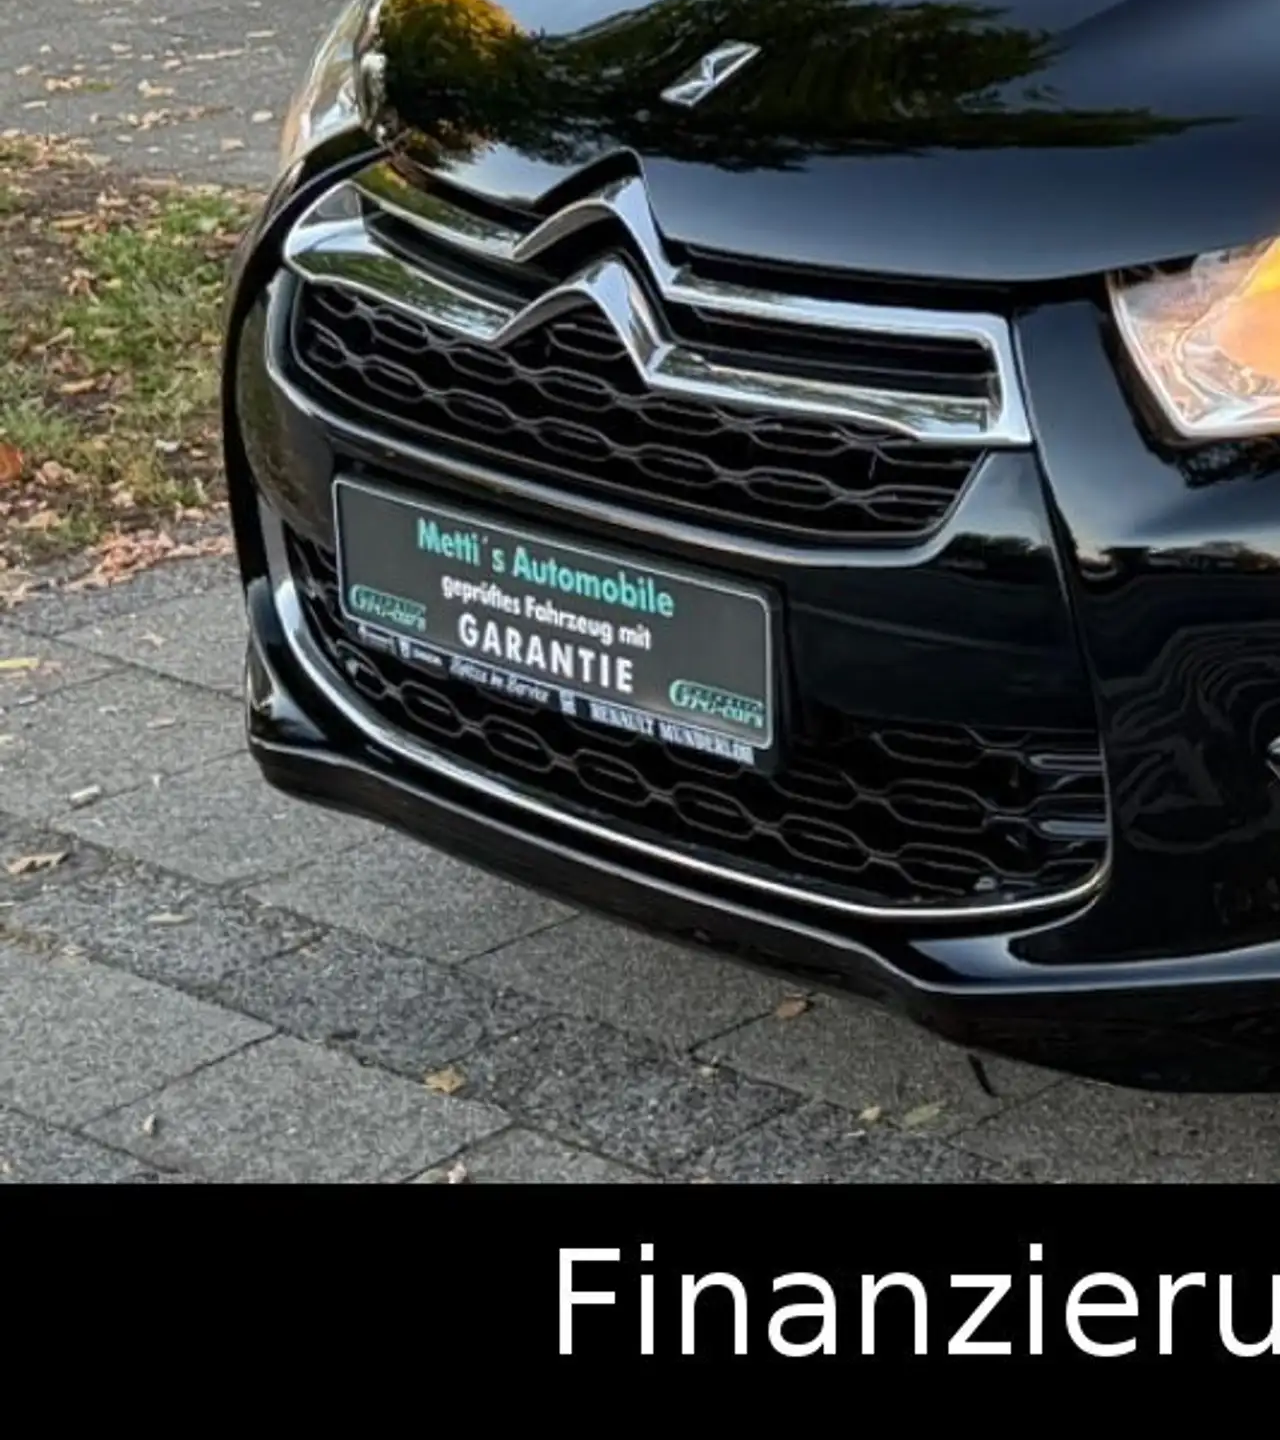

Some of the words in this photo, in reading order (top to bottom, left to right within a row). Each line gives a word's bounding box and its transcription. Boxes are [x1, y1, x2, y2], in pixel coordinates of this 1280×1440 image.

[512, 547, 675, 618] Automobile
[458, 612, 634, 694] GARANTIE
[523, 596, 614, 646] Fahrzeug
[618, 622, 652, 650] mit
